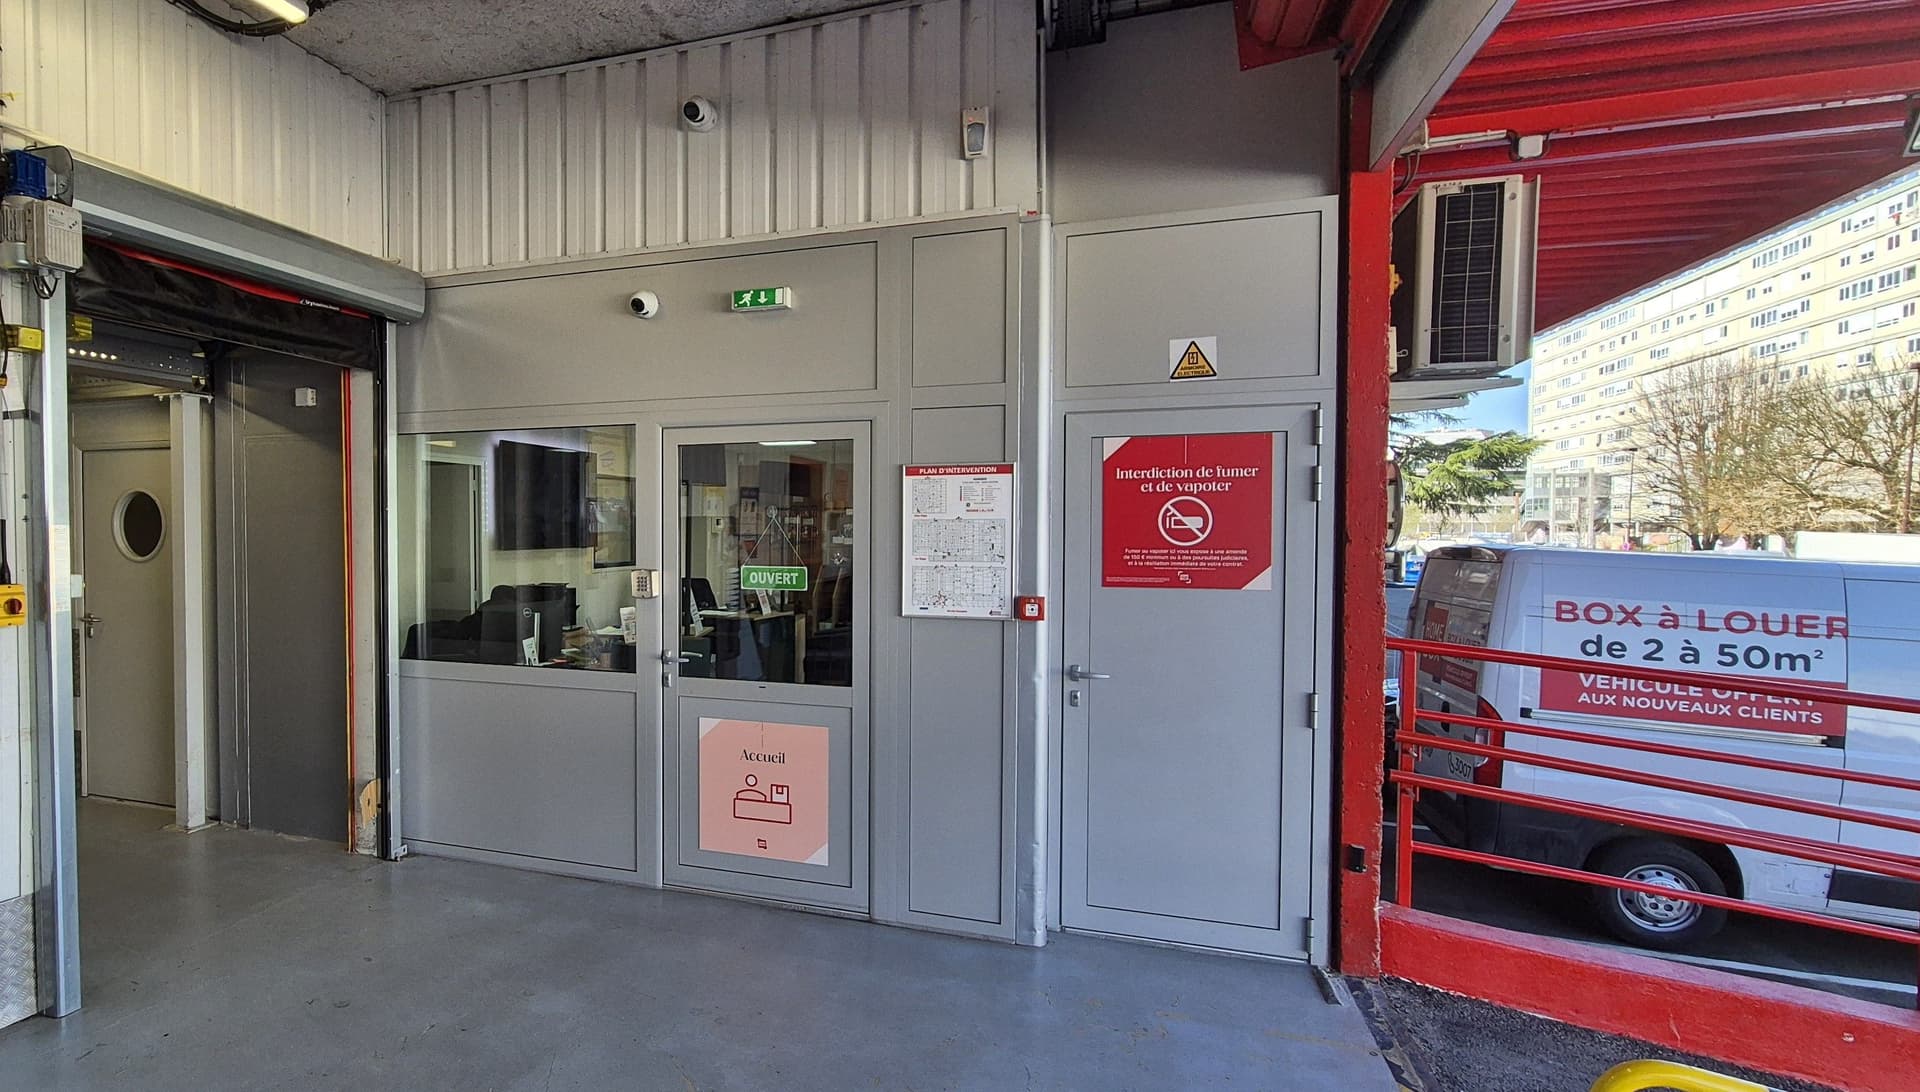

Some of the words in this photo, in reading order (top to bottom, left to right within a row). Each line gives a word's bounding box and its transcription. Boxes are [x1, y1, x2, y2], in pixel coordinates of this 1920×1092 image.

[919, 467, 937, 475] PLAN
[939, 466, 997, 475] D'INTERVENTION
[1116, 466, 1193, 480] Interdiction
[1196, 465, 1214, 478] de
[1216, 465, 1259, 478] fumer
[1140, 481, 1154, 493] et
[1156, 480, 1174, 493] de
[1176, 481, 1232, 494] vapoter
[749, 571, 799, 585] OUVERT
[1554, 600, 1644, 628] BOX
[1657, 604, 1680, 630] à
[1697, 608, 1848, 640] LOUER
[1579, 633, 1628, 660] de
[1641, 637, 1665, 663] 2
[1678, 639, 1701, 666] à
[1716, 642, 1824, 673] 50m²
[1577, 691, 1617, 706] AUX
[1622, 695, 1732, 716] NOUVEAUX
[1737, 705, 1823, 724] CLIENTS
[739, 748, 786, 765] Accueil
